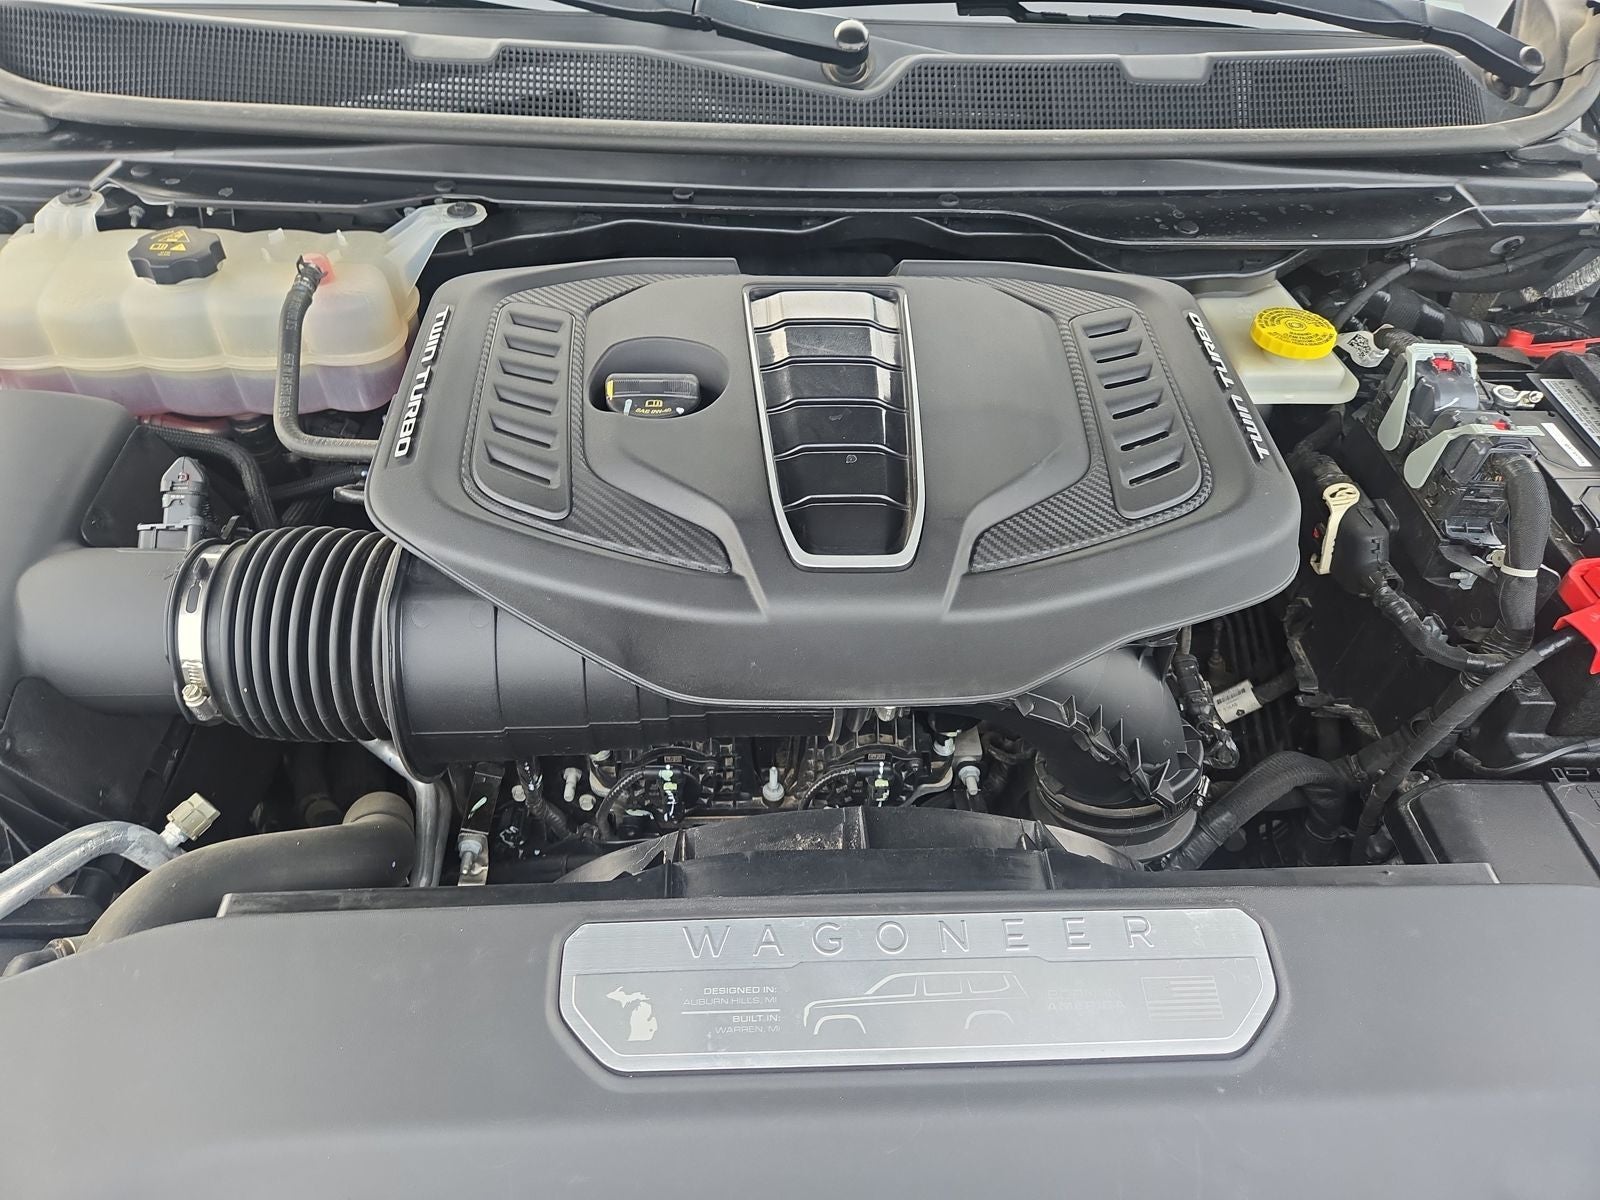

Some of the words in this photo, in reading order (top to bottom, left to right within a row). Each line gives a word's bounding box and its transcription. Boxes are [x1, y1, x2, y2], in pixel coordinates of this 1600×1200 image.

[421, 305, 450, 364] TWIN
[1188, 311, 1235, 388] TURBO
[394, 365, 432, 459] TURBO
[1231, 394, 1270, 461] TWIN
[682, 914, 1155, 959] WAGONEER
[683, 997, 729, 1006] AUBURN
[764, 996, 777, 1004] MI
[703, 986, 760, 995] DESIGNED
[763, 986, 777, 994] IN:
[732, 1014, 763, 1023] BUILT
[766, 1014, 781, 1023] IN:
[768, 1025, 781, 1033] MI
